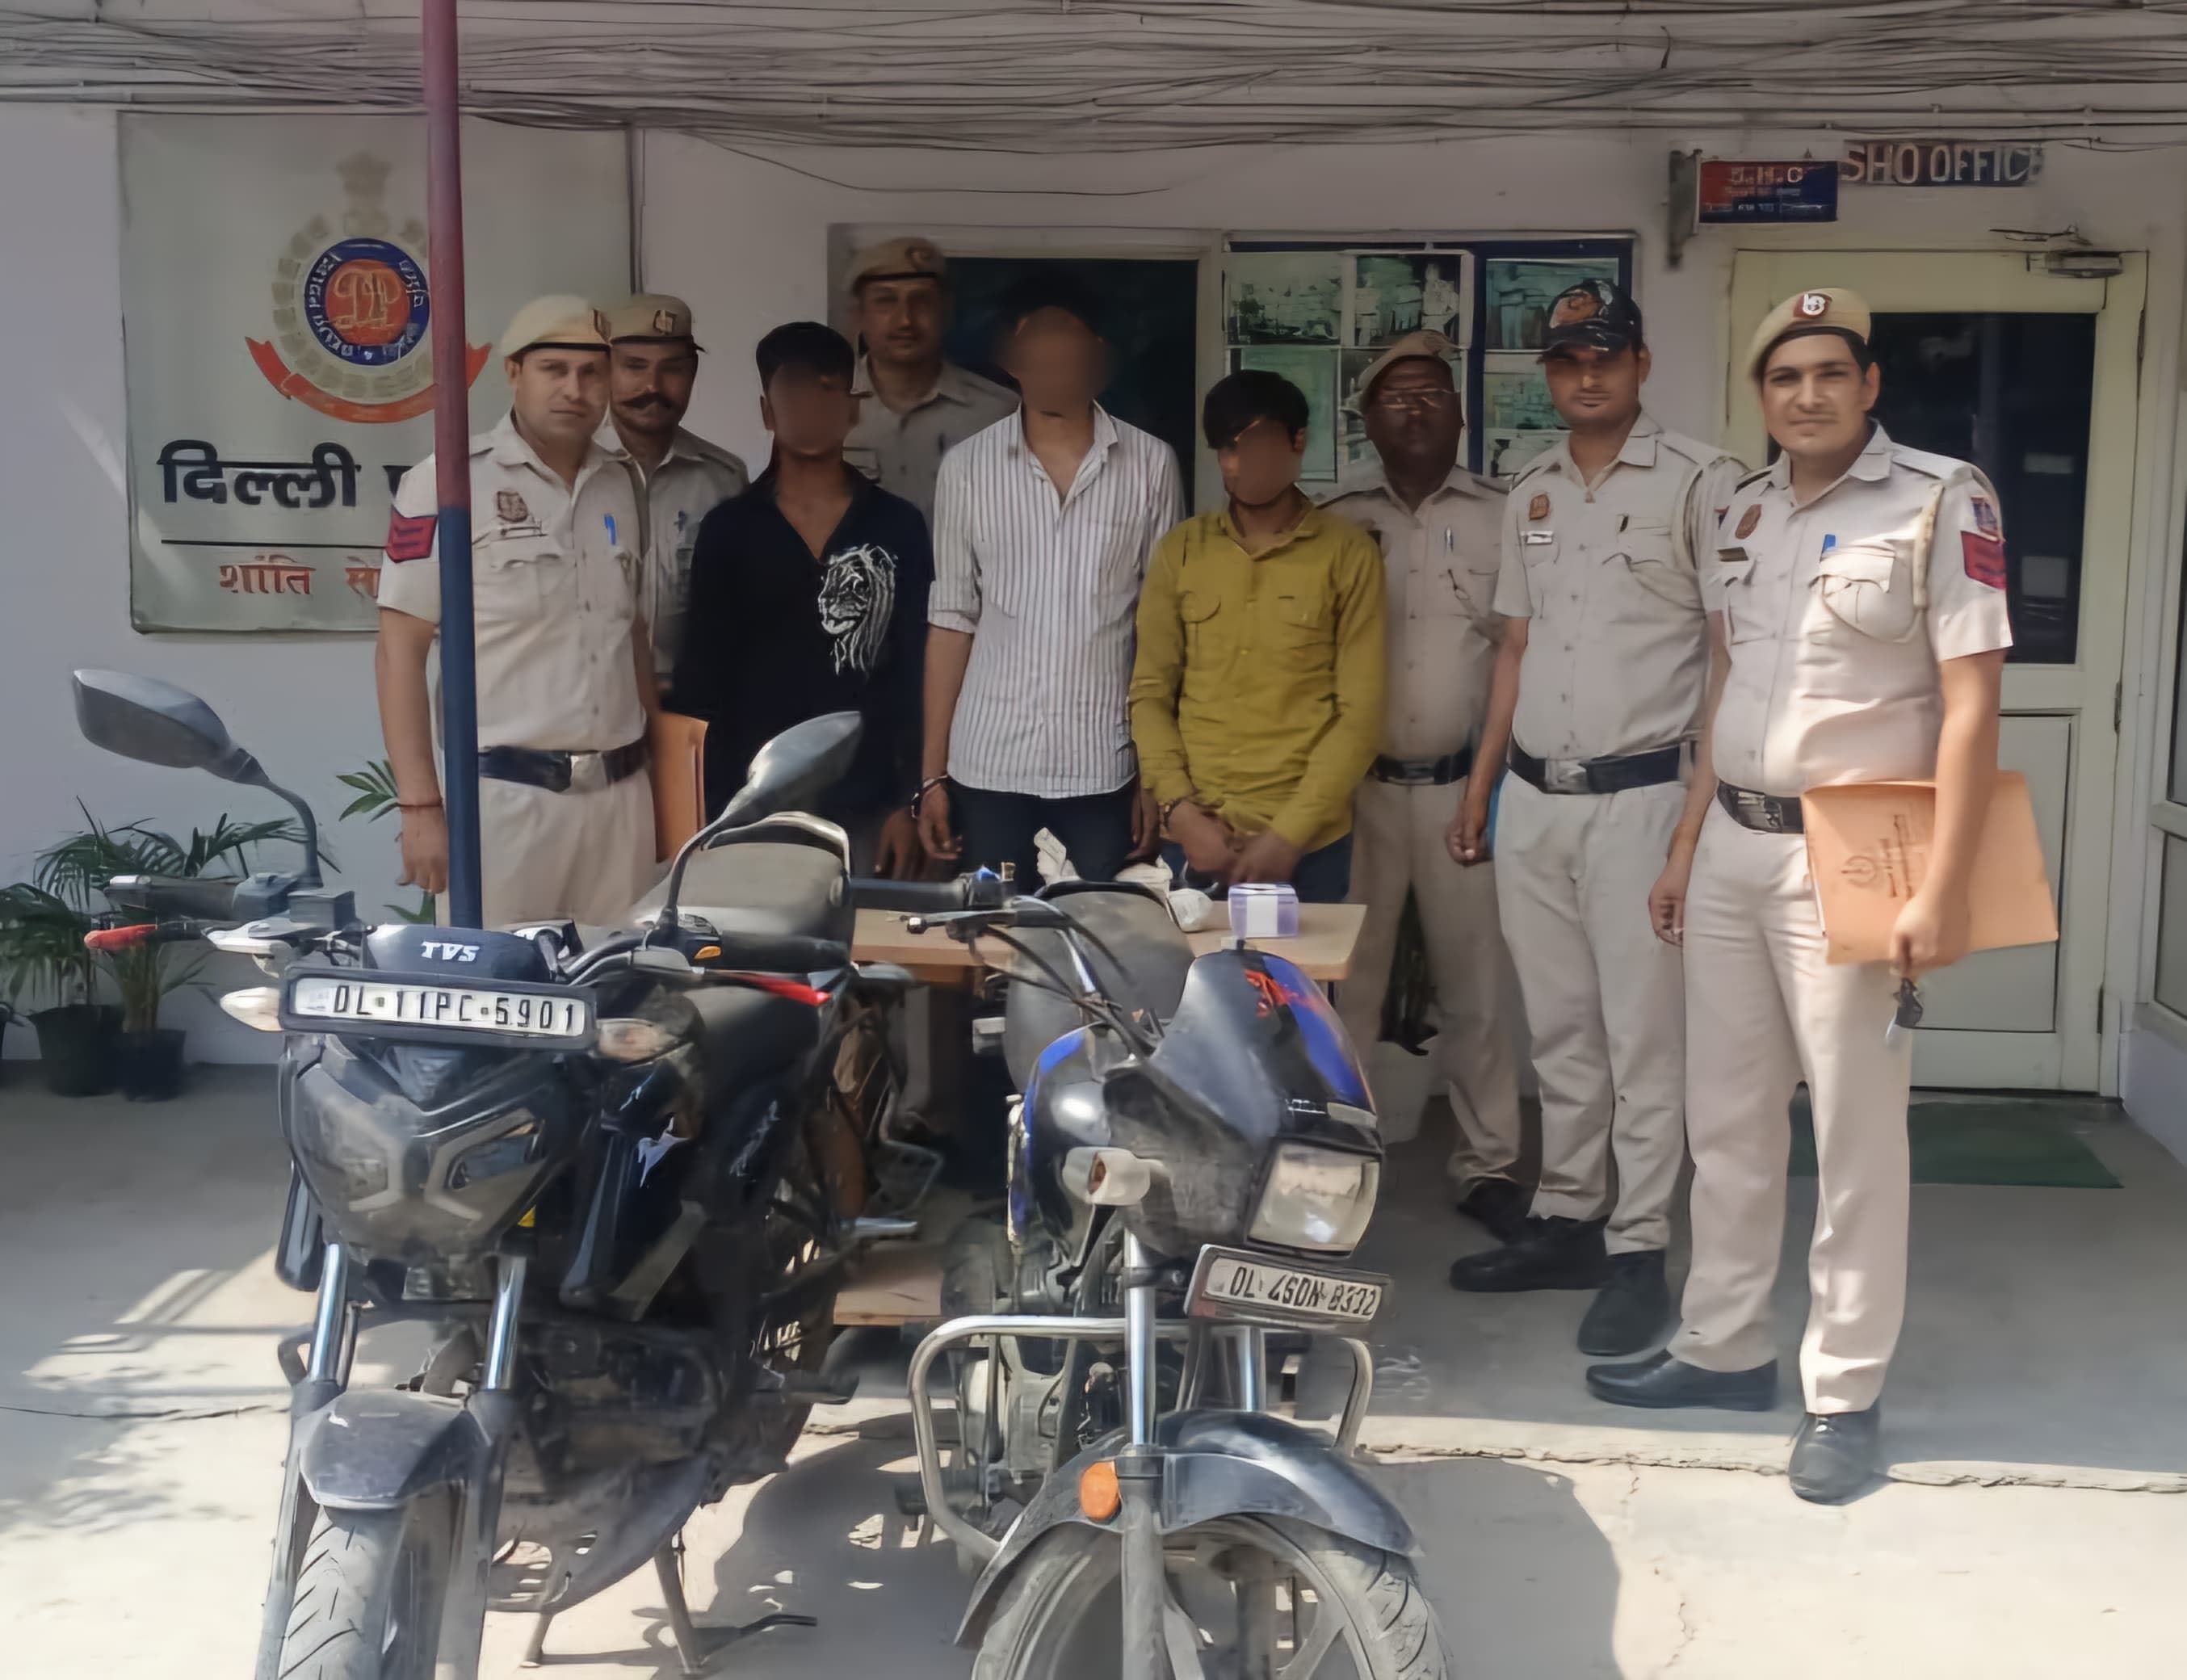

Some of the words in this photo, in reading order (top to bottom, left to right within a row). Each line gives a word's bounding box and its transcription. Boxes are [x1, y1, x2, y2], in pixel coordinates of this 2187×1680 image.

[1840, 142, 1920, 184] SHO
[156, 439, 363, 509] दिल्ली
[219, 554, 317, 595] शांति
[420, 940, 481, 963] TVS
